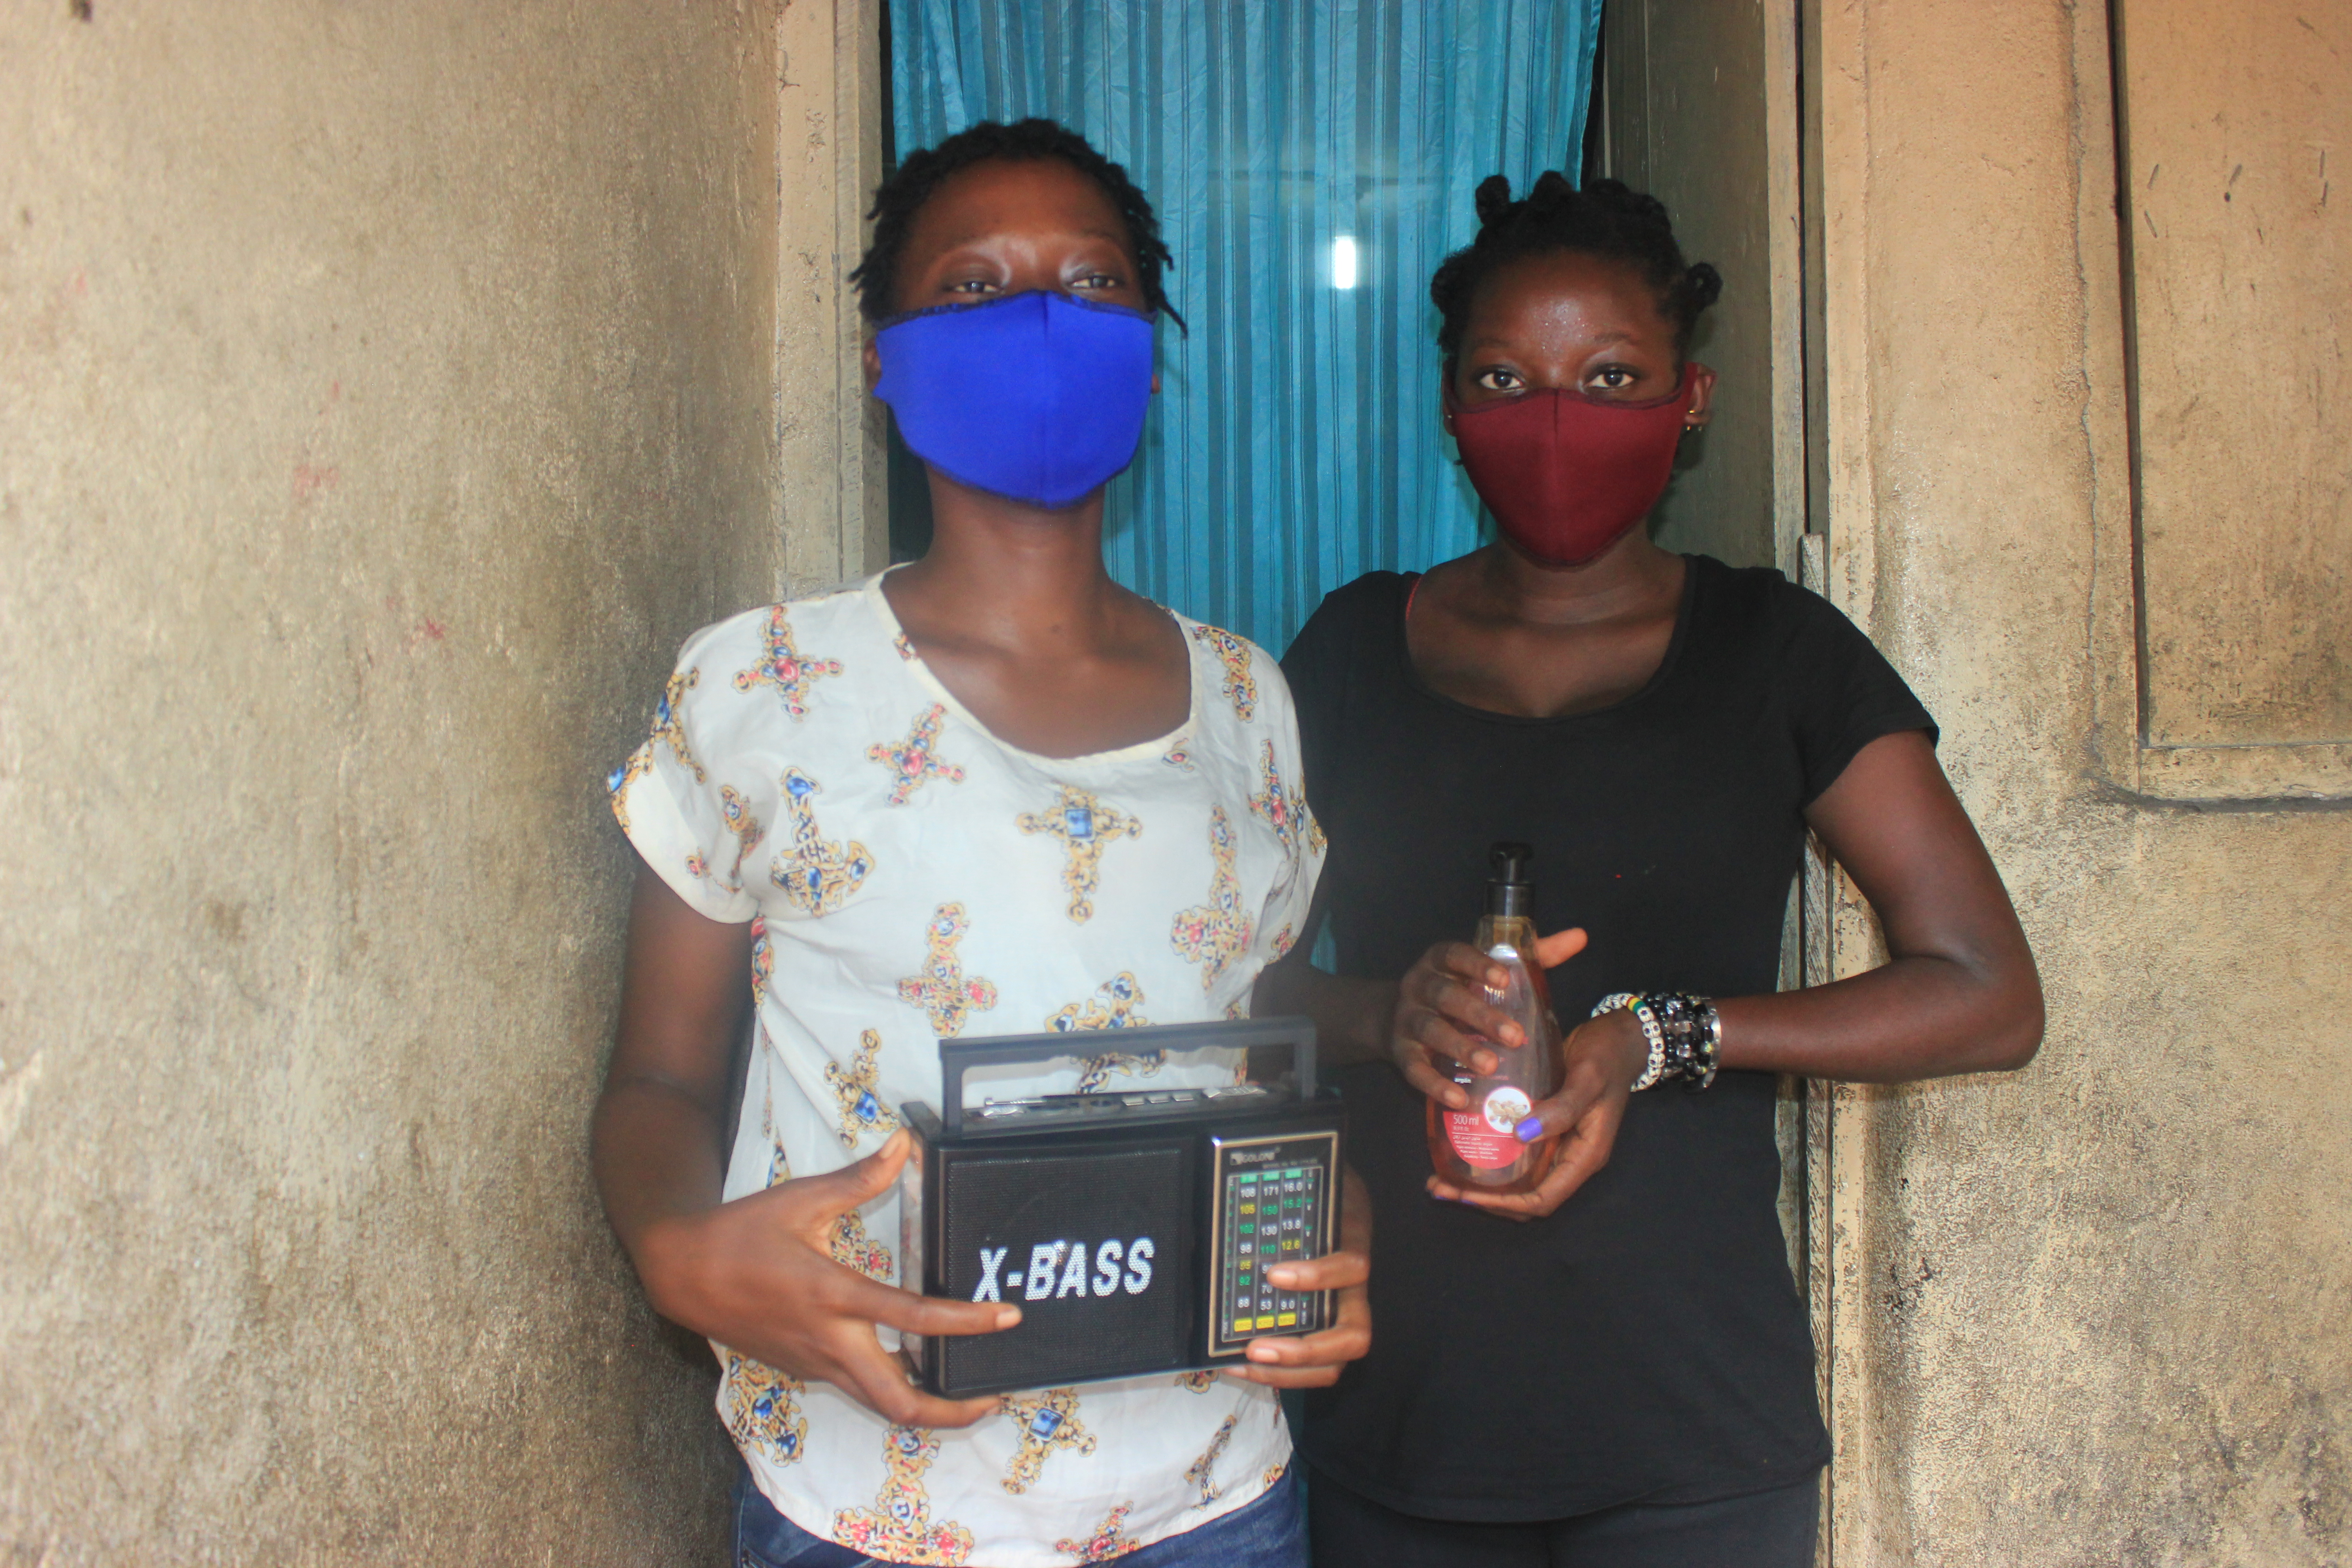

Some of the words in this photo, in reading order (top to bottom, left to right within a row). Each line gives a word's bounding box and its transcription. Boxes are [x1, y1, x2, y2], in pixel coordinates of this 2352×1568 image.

[1453, 1114, 1468, 1125] 500
[1469, 1116, 1479, 1126] ml
[1263, 1185, 1279, 1196] 171
[1284, 1181, 1303, 1192] 16.0
[1284, 1198, 1302, 1209] 15.2
[1240, 1204, 1255, 1215] 105
[1262, 1205, 1279, 1215] 150
[1282, 1219, 1301, 1230] 13.8
[1261, 1225, 1277, 1236] 130
[1261, 1245, 1276, 1254] 110
[1282, 1240, 1300, 1250] 12.6
[972, 1237, 1155, 1303] X-BASS
[1261, 1262, 1272, 1274] 9
[1239, 1275, 1251, 1286] 92
[1260, 1299, 1272, 1310] 53
[1280, 1299, 1295, 1310] 9.0
